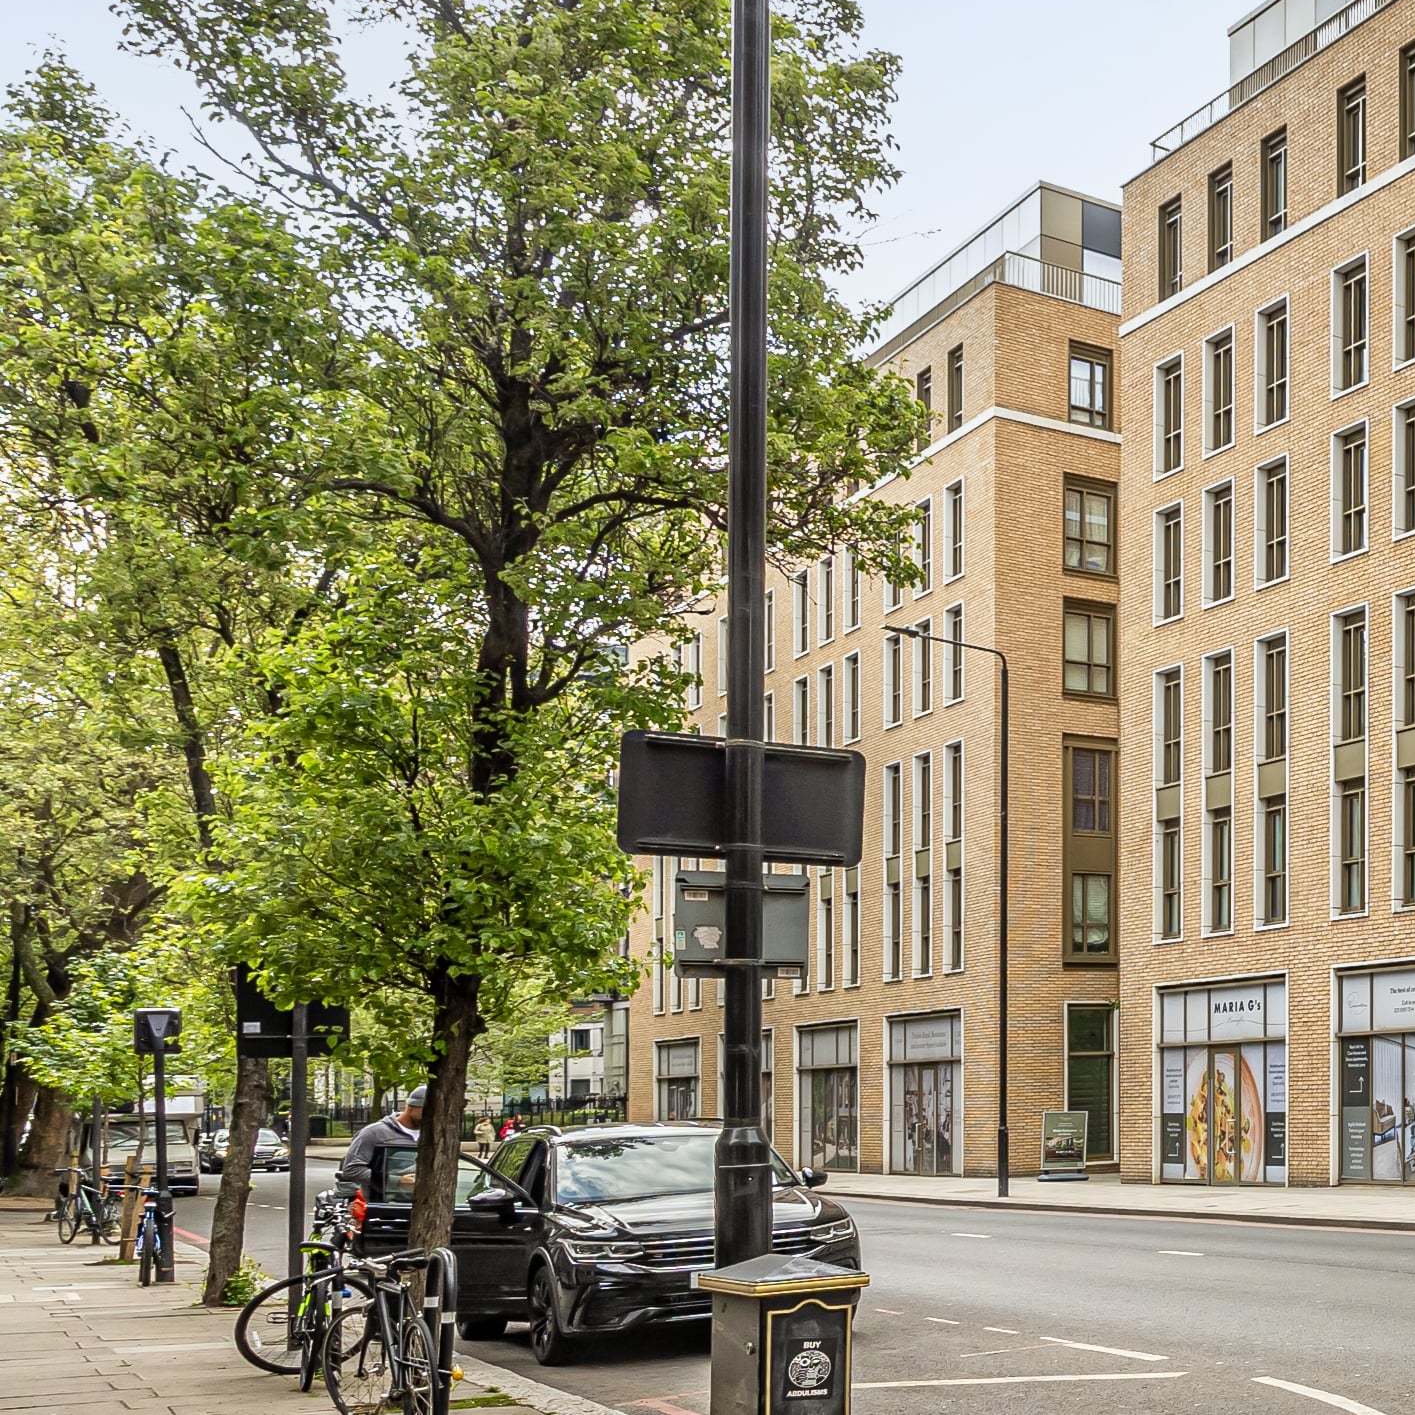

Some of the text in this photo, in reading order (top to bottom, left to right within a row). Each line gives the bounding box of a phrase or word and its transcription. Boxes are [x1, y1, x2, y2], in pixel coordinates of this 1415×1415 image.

[1214, 1000, 1261, 1014] MARIA G's
[803, 1341, 821, 1349] BUY
